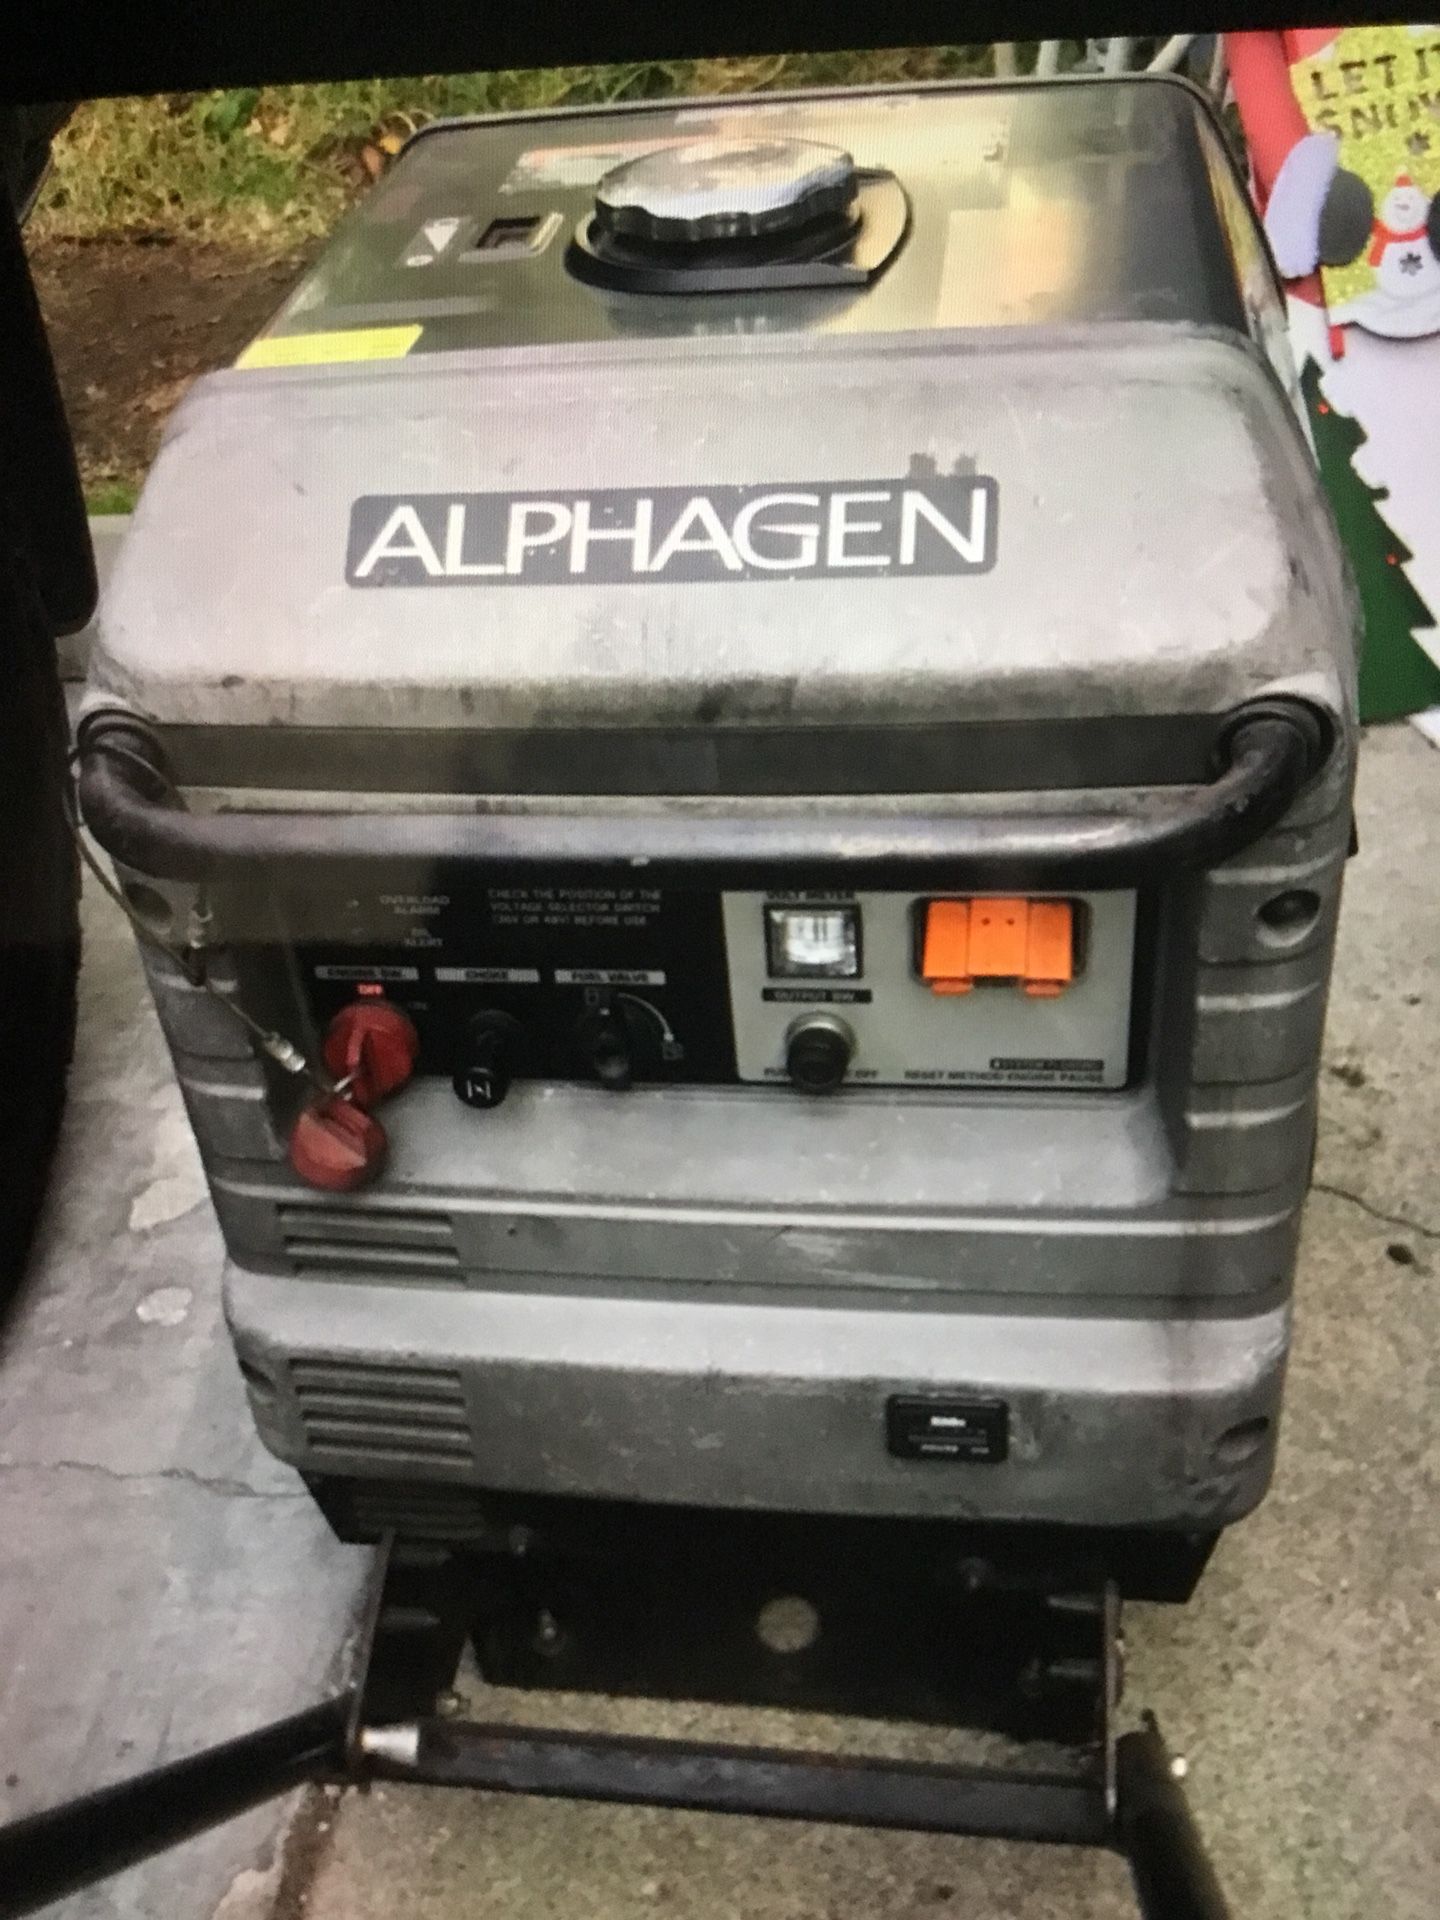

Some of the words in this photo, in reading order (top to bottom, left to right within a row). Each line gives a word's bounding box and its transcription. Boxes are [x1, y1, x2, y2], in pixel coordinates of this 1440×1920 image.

[1311, 54, 1397, 100] LET
[354, 488, 987, 578] ALPHAGEN
[487, 888, 528, 900] CHECK
[532, 889, 555, 900] THE
[379, 895, 450, 906] OVERLOAD
[490, 901, 543, 913] VOLTAGE
